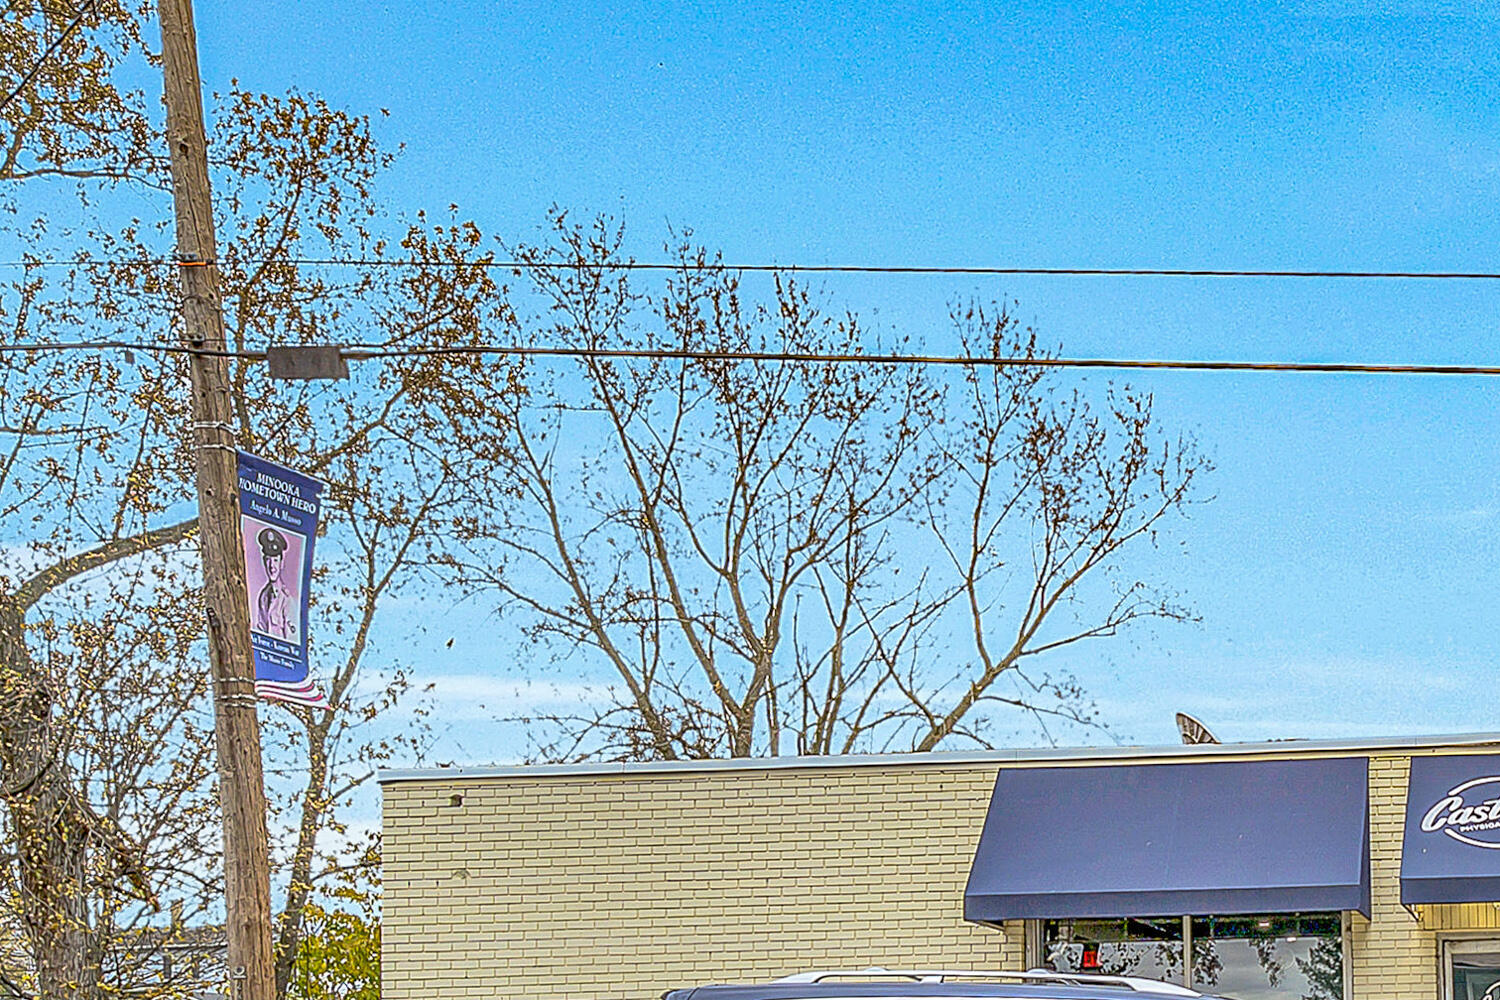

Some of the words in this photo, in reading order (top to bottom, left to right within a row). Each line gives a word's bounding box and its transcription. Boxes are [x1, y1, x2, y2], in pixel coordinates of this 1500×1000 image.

[239, 478, 291, 505] HOMETOWN
[291, 497, 316, 514] HERO
[257, 473, 300, 497] MINOOKA
